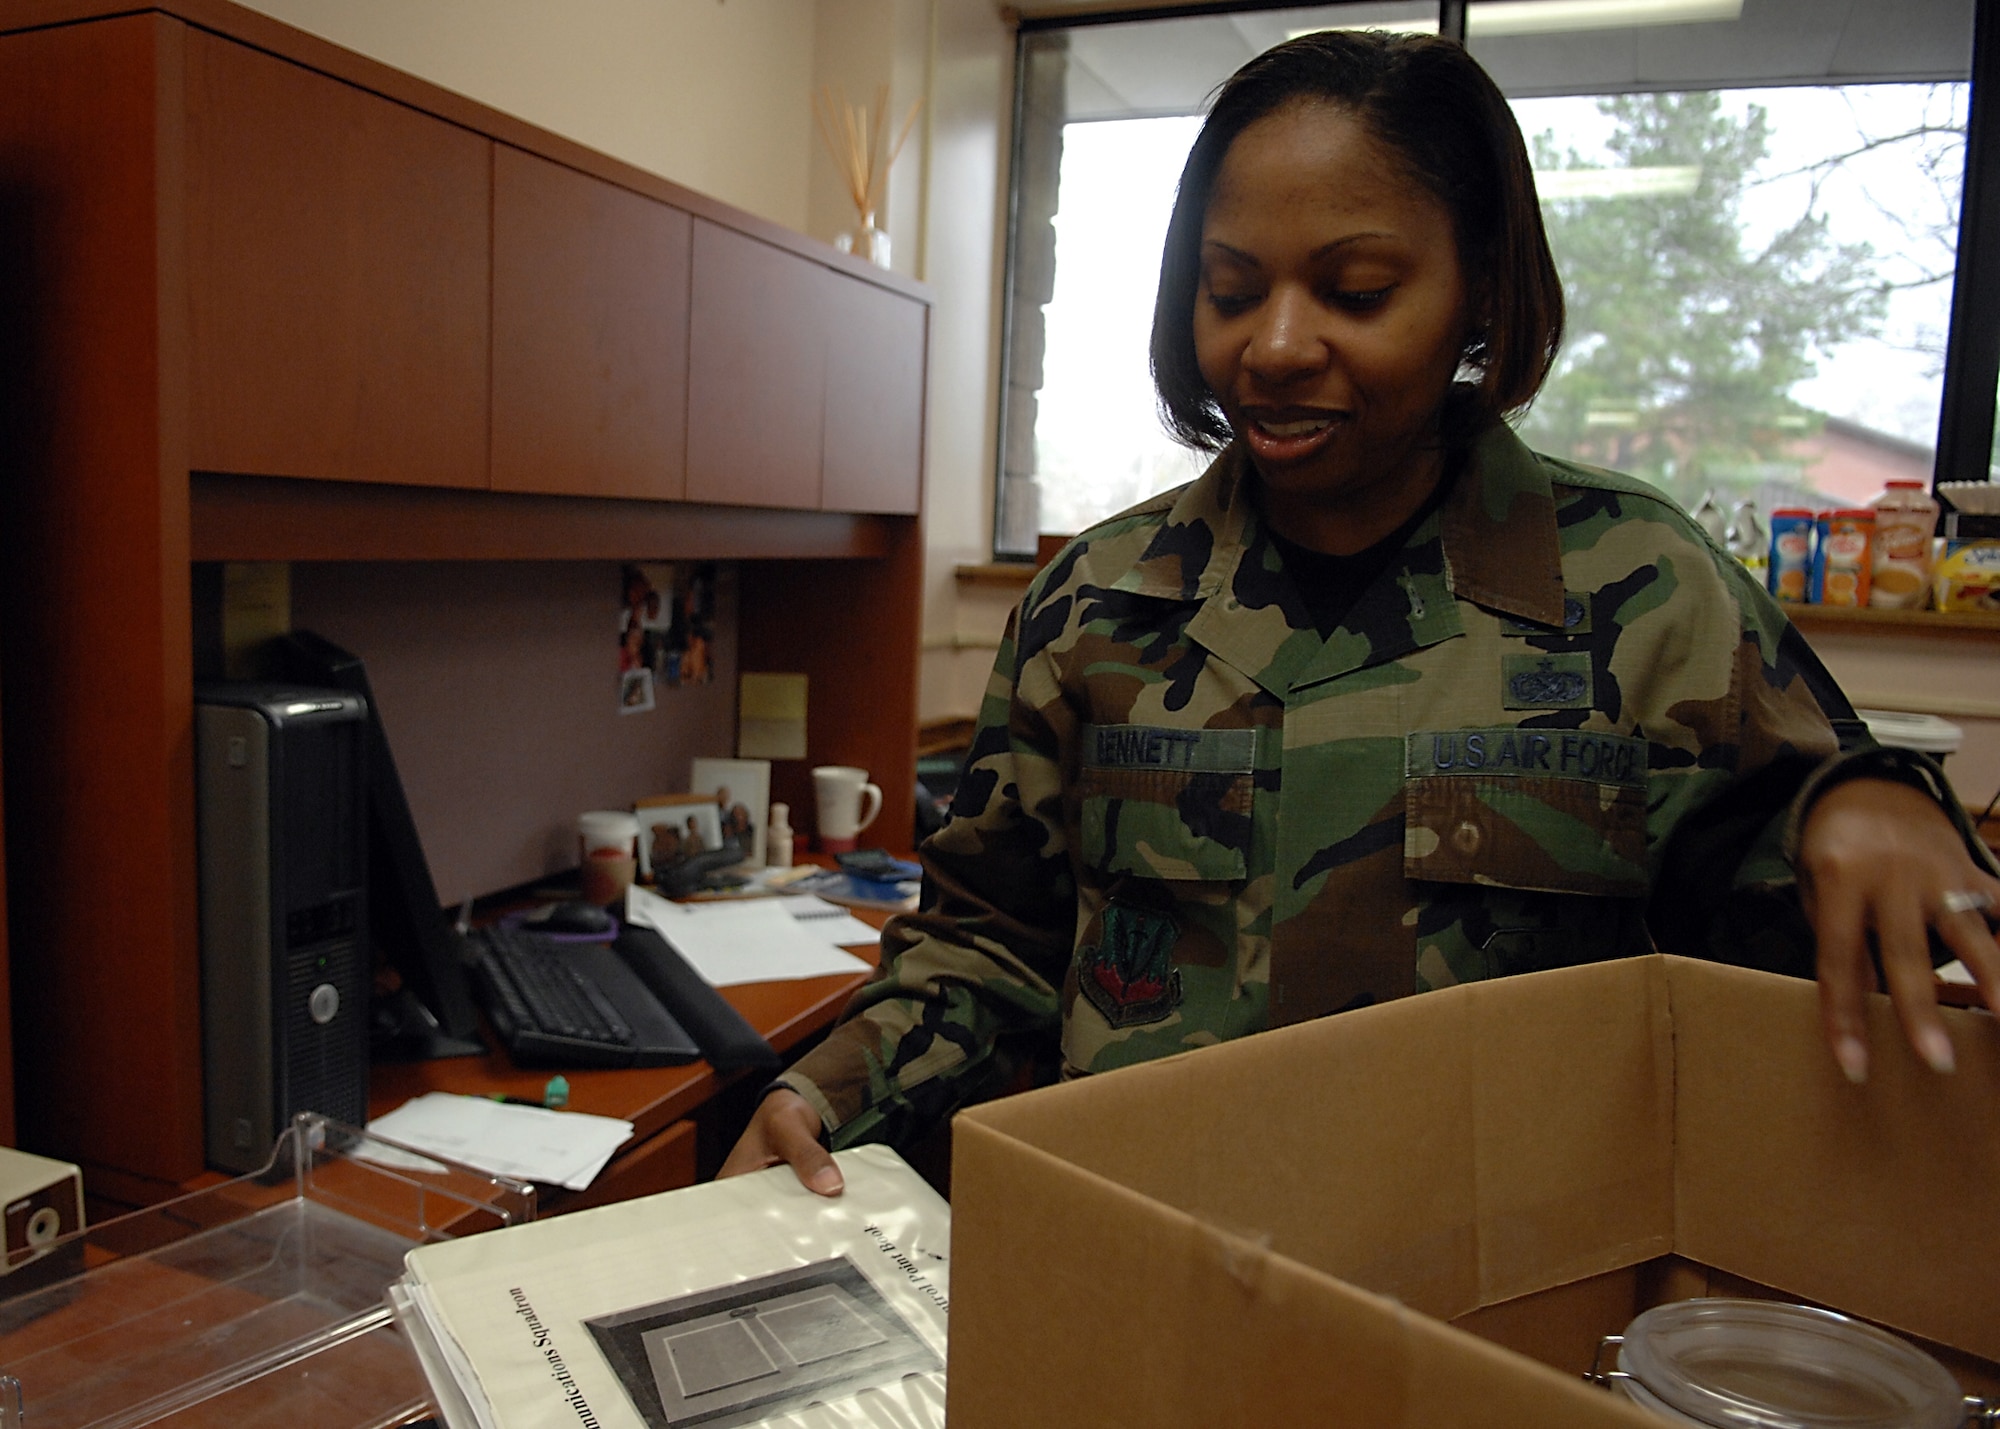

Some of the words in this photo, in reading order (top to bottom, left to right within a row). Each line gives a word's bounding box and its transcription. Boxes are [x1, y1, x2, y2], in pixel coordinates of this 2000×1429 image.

[1498, 734, 1551, 770] AIR
[1560, 736, 1641, 780] FORCE
[864, 1224, 896, 1253] Book
[890, 1253, 925, 1283] Point
[509, 1287, 552, 1348] Squadron
